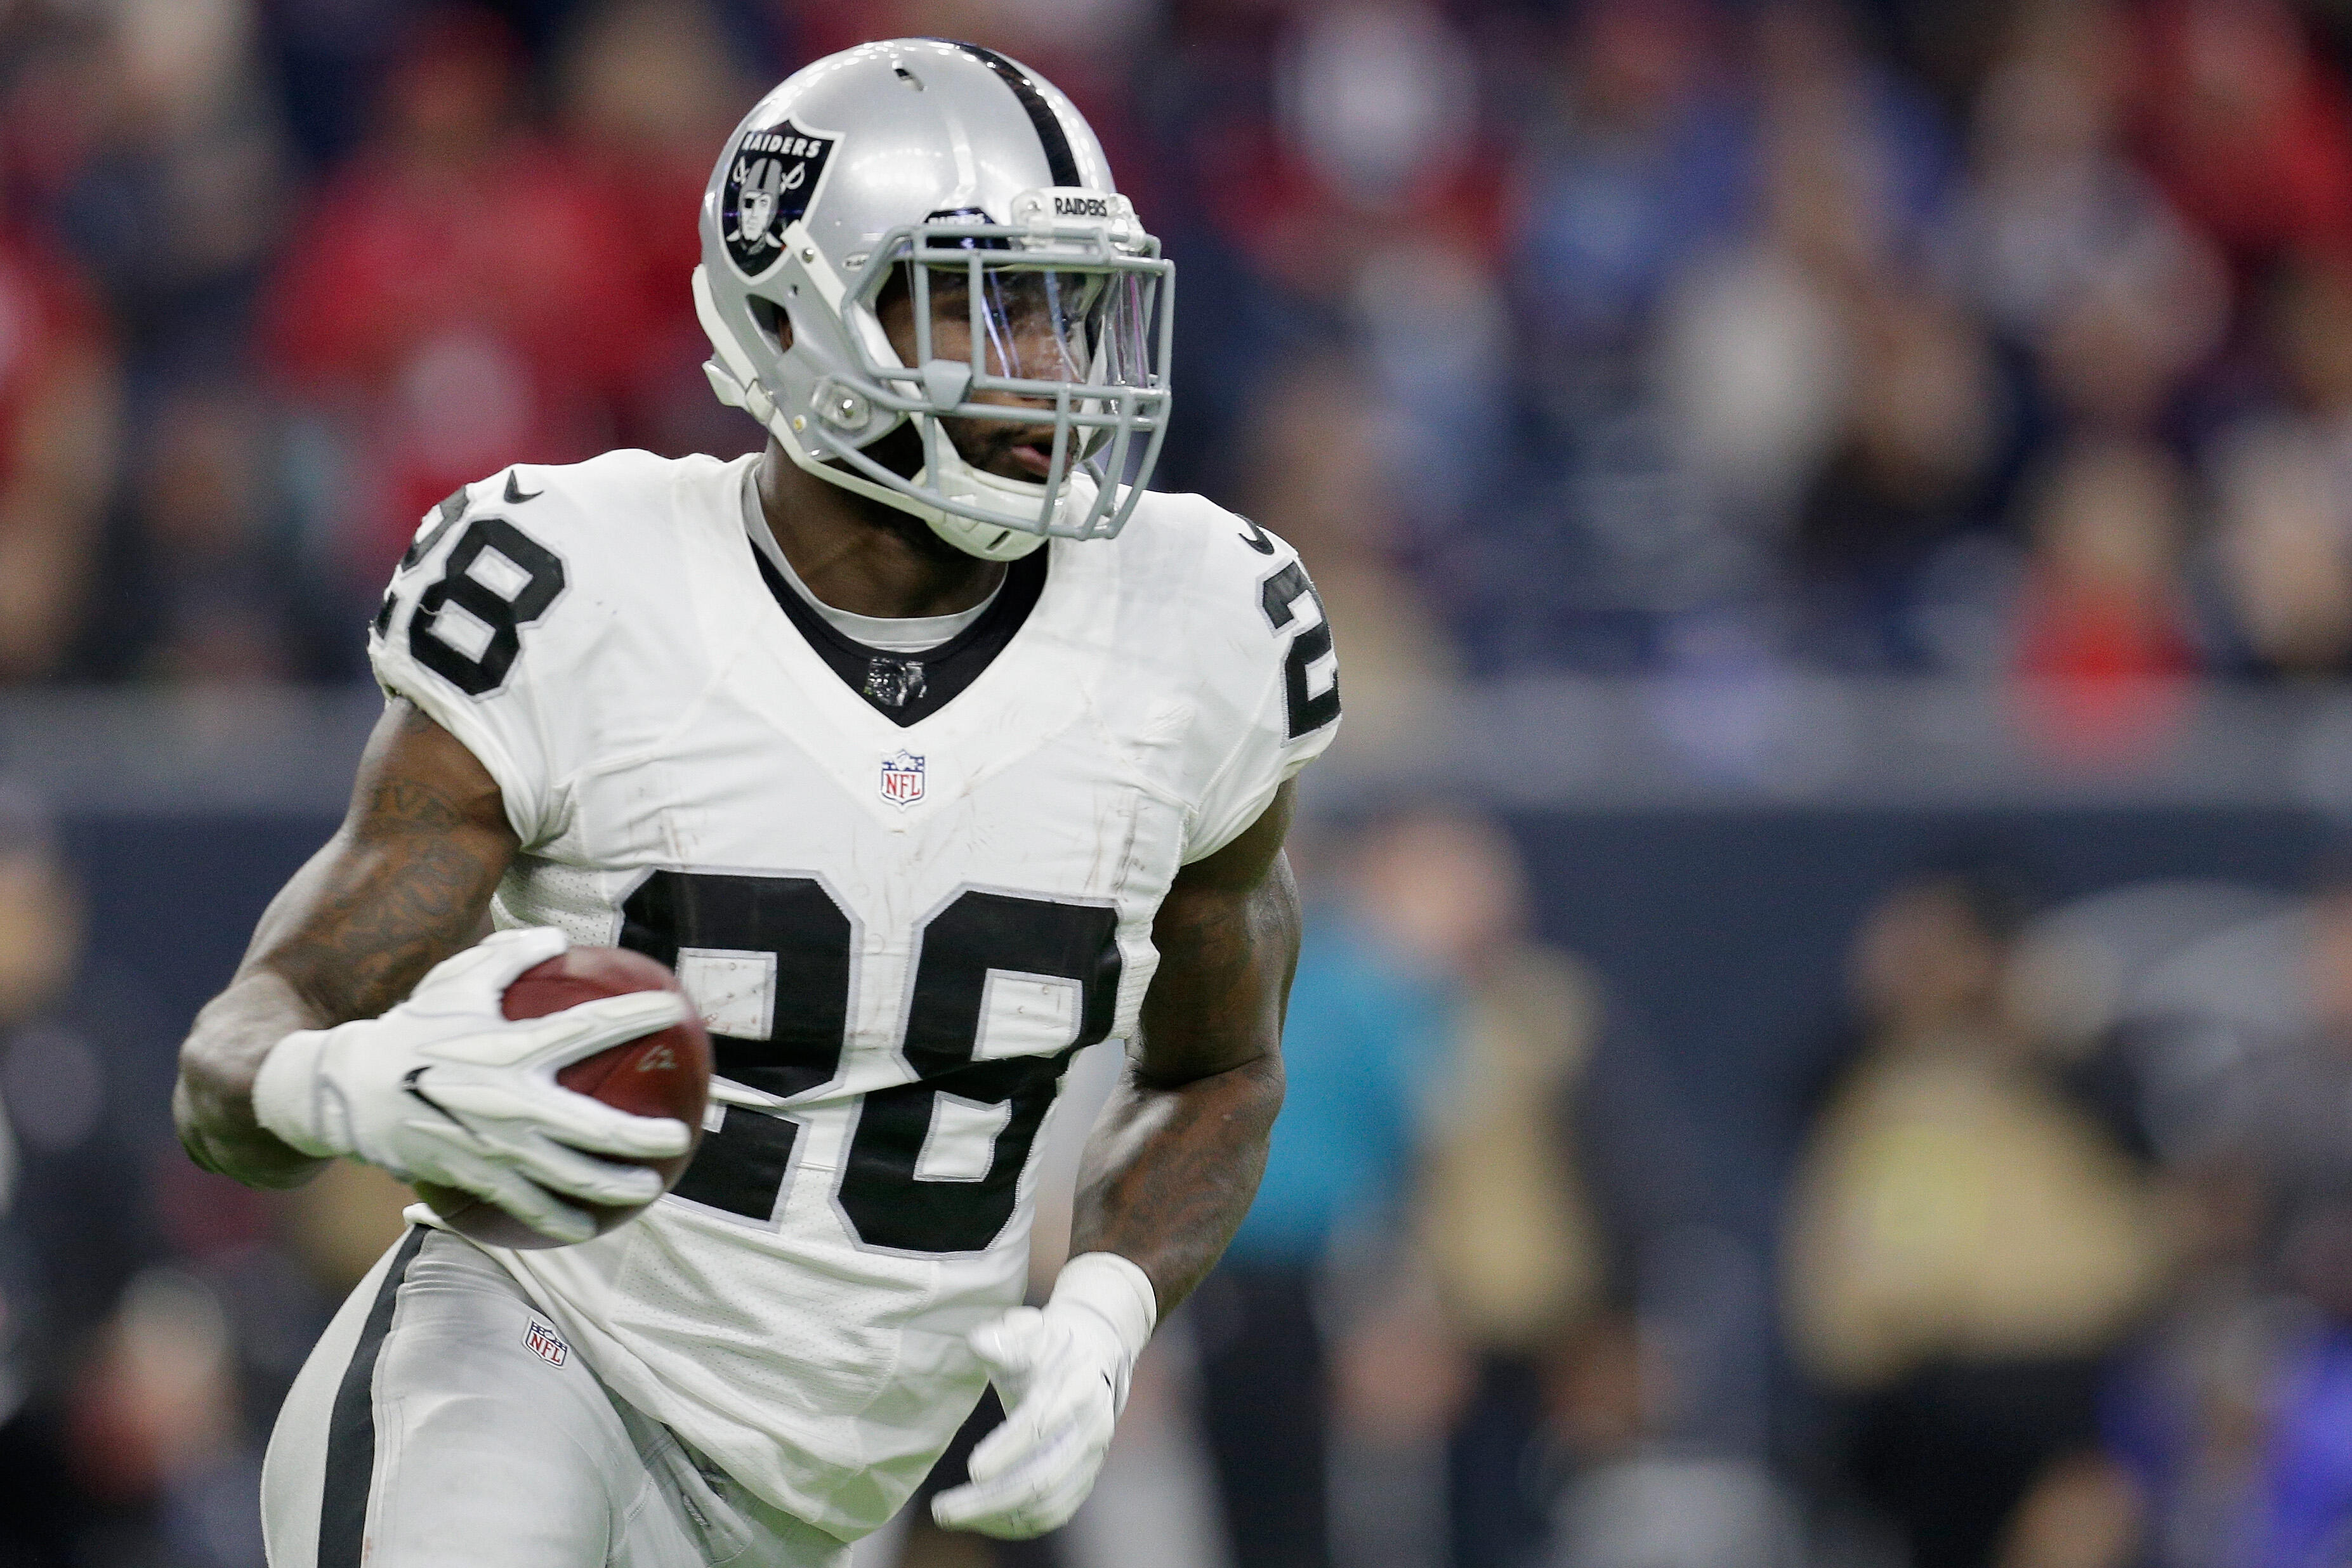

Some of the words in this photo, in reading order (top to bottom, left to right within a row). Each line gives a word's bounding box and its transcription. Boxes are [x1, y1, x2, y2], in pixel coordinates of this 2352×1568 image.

[1054, 197, 1107, 216] RAIDERS
[886, 773, 921, 798] NFL
[610, 865, 1126, 1260] 28
[529, 1333, 561, 1363] NFL
